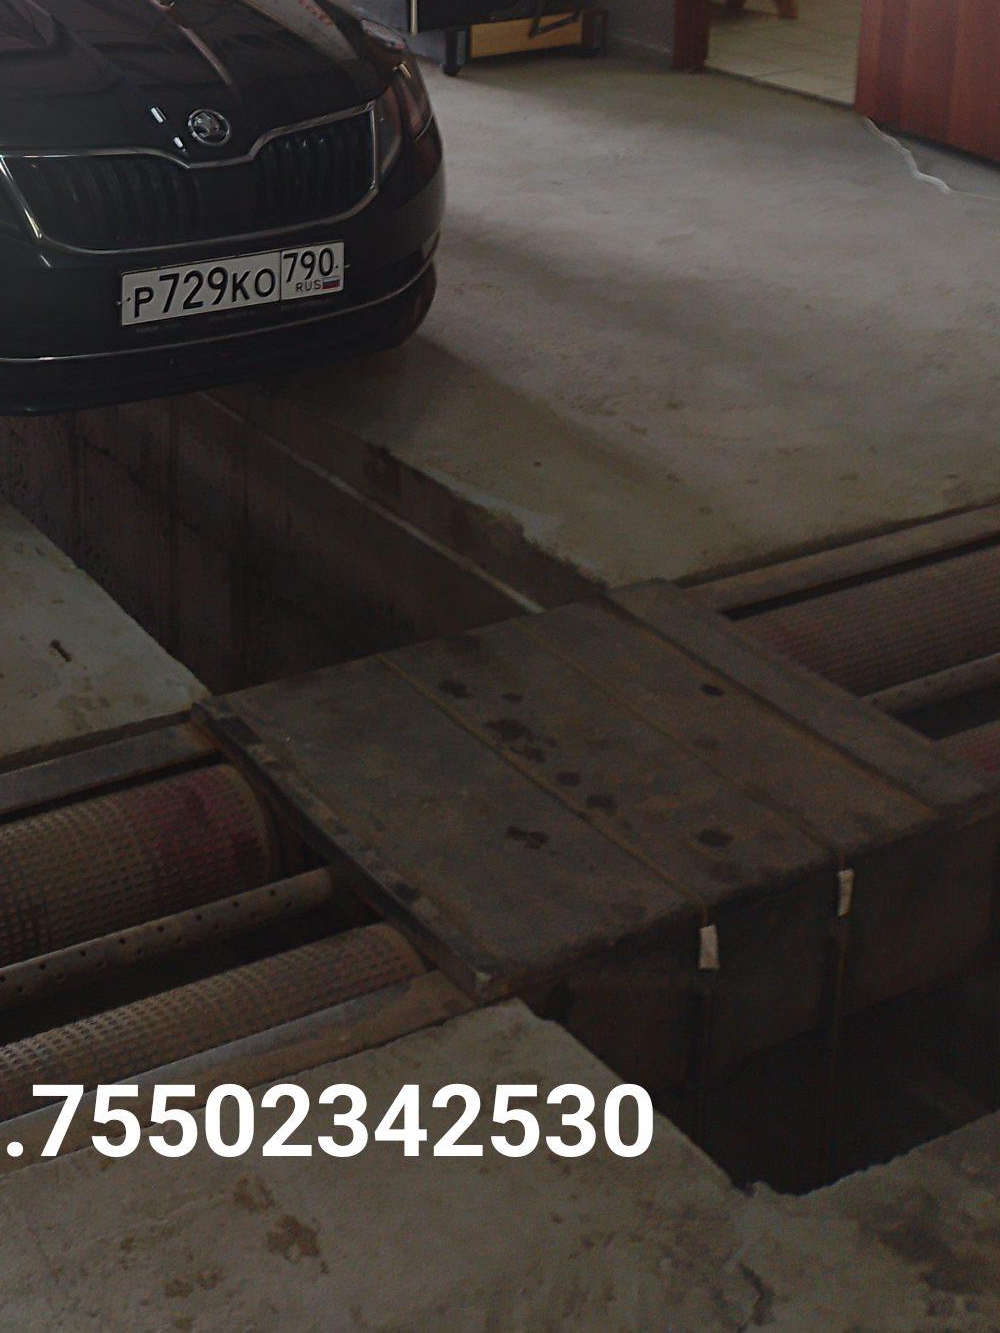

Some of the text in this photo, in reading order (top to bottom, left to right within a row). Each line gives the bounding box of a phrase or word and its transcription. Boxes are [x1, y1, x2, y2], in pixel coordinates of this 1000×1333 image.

[133, 247, 335, 318] Р729КО 790
[296, 279, 322, 293] RUS
